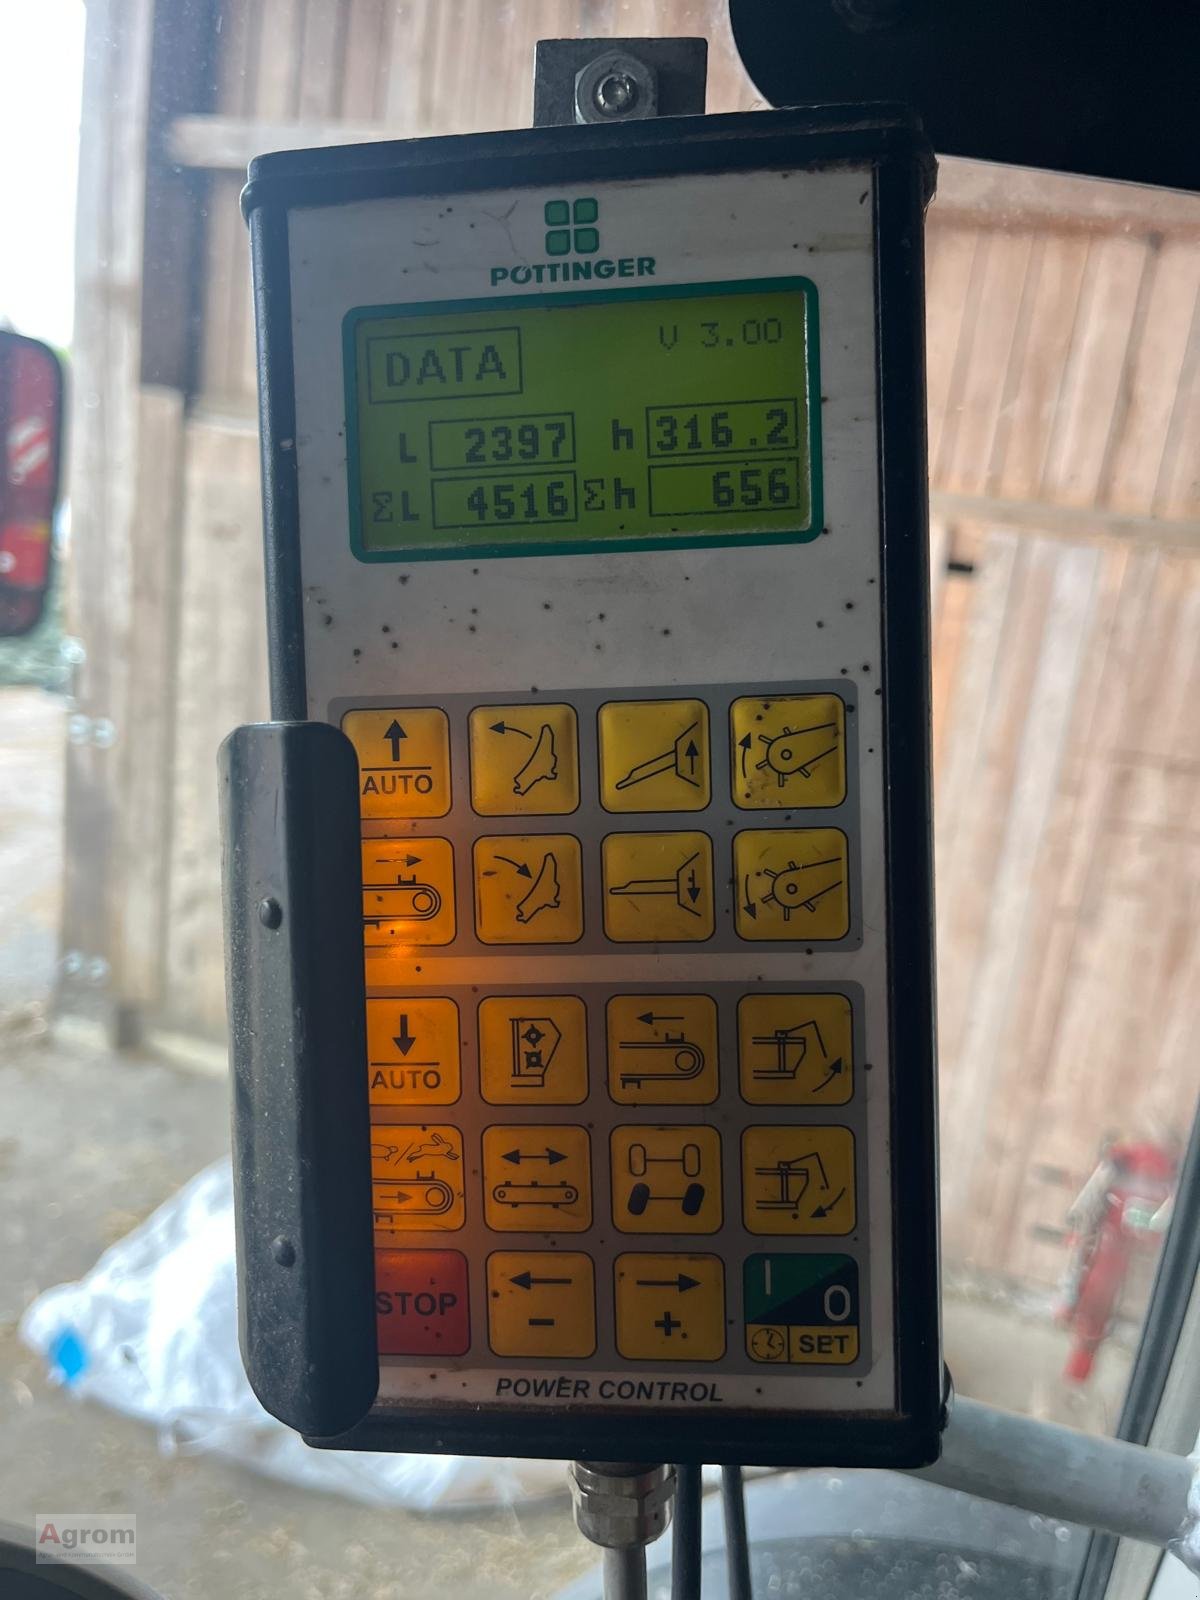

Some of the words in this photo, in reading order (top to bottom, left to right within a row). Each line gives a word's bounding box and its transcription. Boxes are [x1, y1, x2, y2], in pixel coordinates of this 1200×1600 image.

[490, 256, 657, 287] PÖTTINGER
[700, 317, 783, 347] 3.00
[385, 344, 507, 388] DATA
[400, 432, 418, 464] L
[465, 422, 567, 464] 2397
[612, 418, 635, 452] h
[467, 481, 569, 522] 4516
[712, 467, 791, 507] 656
[361, 773, 434, 796] AUTO
[370, 1069, 442, 1090] AUTO
[376, 1291, 458, 1317] STOP
[799, 1333, 850, 1355] SET
[495, 1377, 591, 1399] POWER
[598, 1379, 724, 1403] CONTROL
